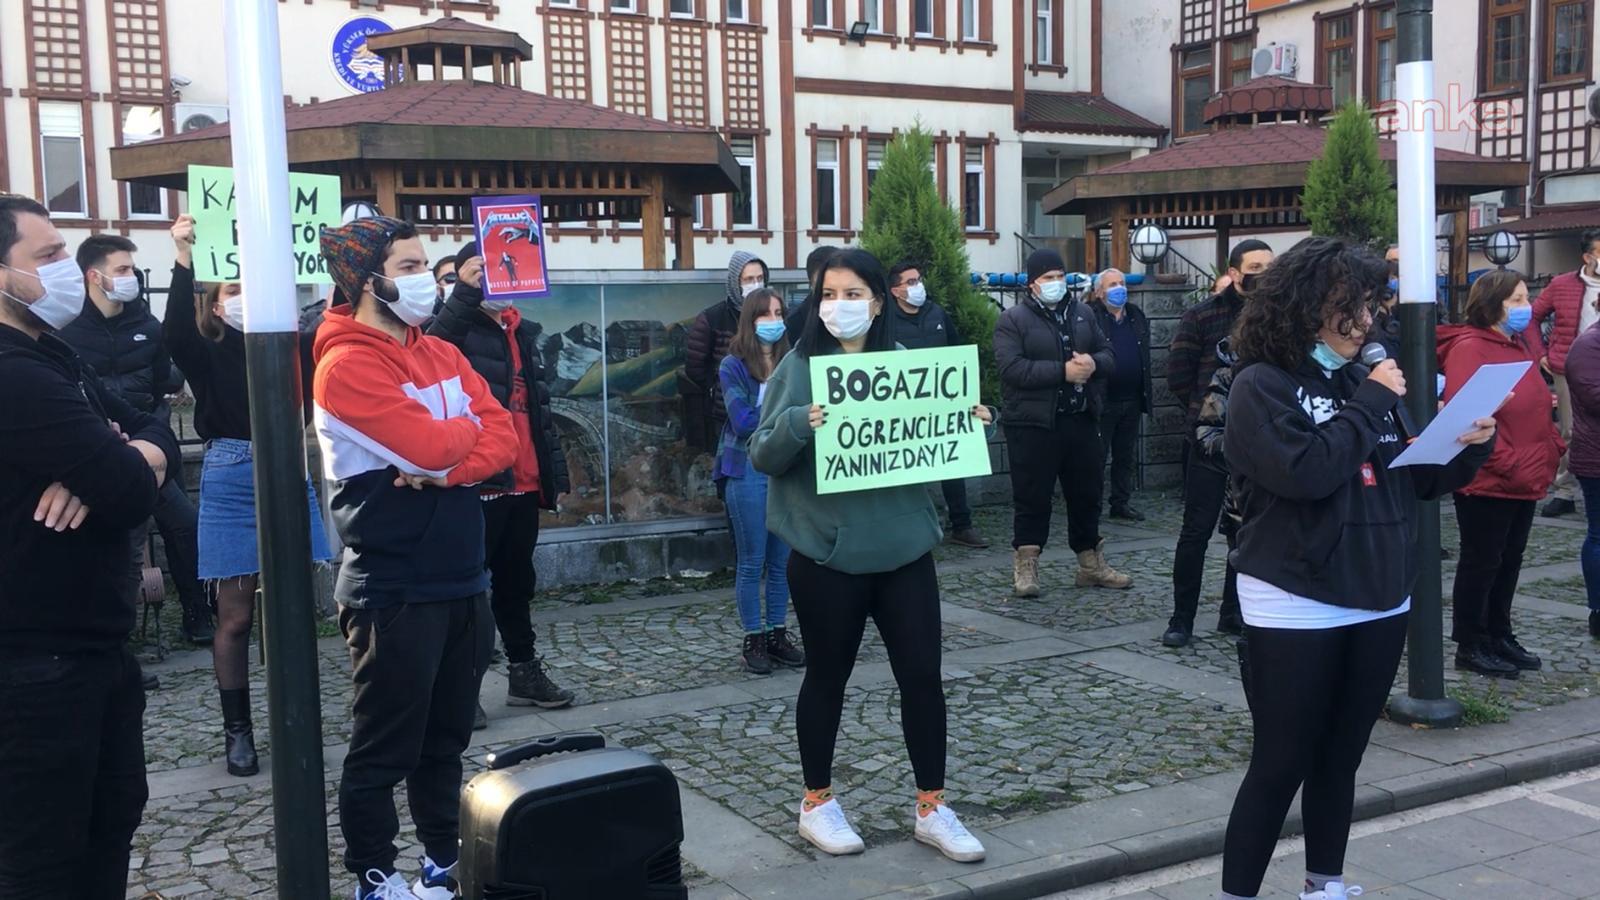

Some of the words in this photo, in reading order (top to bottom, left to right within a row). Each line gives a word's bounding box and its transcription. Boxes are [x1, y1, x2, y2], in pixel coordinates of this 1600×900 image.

[826, 361, 968, 405] BOĞAZİÇİ
[837, 407, 974, 450] ÖĞRENCİLERİ
[825, 440, 960, 481] YANINIZDAYIZ
